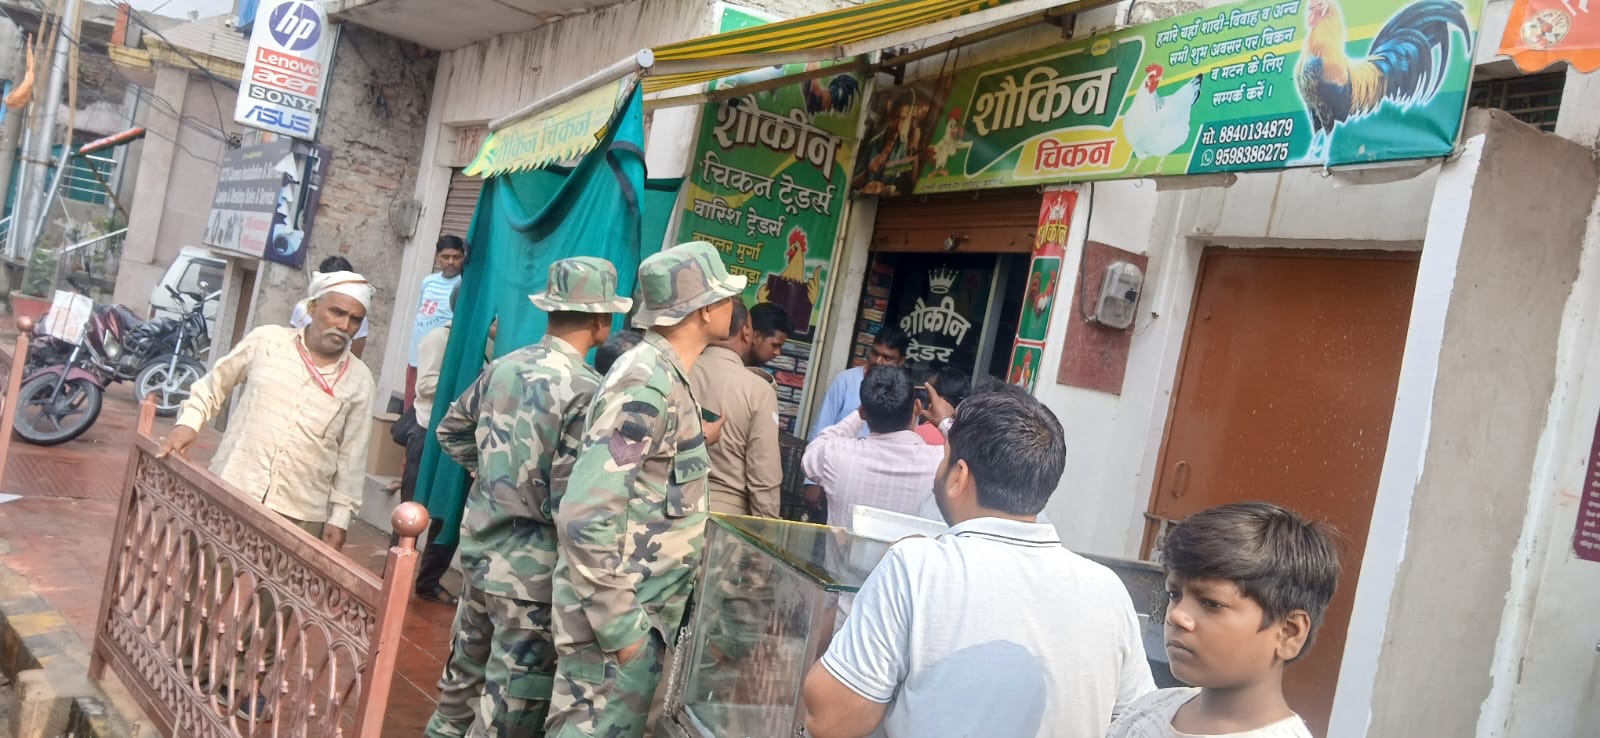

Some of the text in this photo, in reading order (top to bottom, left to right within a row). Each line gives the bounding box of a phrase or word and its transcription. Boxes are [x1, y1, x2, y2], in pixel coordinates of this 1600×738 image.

[272, 1, 318, 50] hp
[1156, 1, 1300, 46] हमारे यहाँ शादी-विवाह व अन्य
[1210, 38, 1242, 57] अवसर
[1245, 35, 1258, 50] पर
[1261, 27, 1295, 47] चिकन
[258, 48, 320, 76] Lenovo
[1210, 54, 1284, 81] व मटन के लिए
[253, 68, 319, 92] acer
[1212, 84, 1244, 106] सम्पर्क
[1246, 80, 1265, 100] करें
[251, 85, 314, 111] SONY
[972, 66, 1118, 137] शौकिन
[244, 105, 311, 133] ASUS
[1202, 118, 1293, 144] मो. 8840134879
[713, 94, 841, 180] शौकीन
[1035, 138, 1116, 170] चिकन
[1215, 143, 1289, 166] 9598386275
[703, 151, 836, 215] चिकन ट्रेडर्स
[694, 196, 786, 237] वारिश ट्रेडर्स
[737, 242, 763, 263] मुर्गा
[900, 296, 972, 346] शौकीन
[906, 338, 954, 363] ट्रेडर
